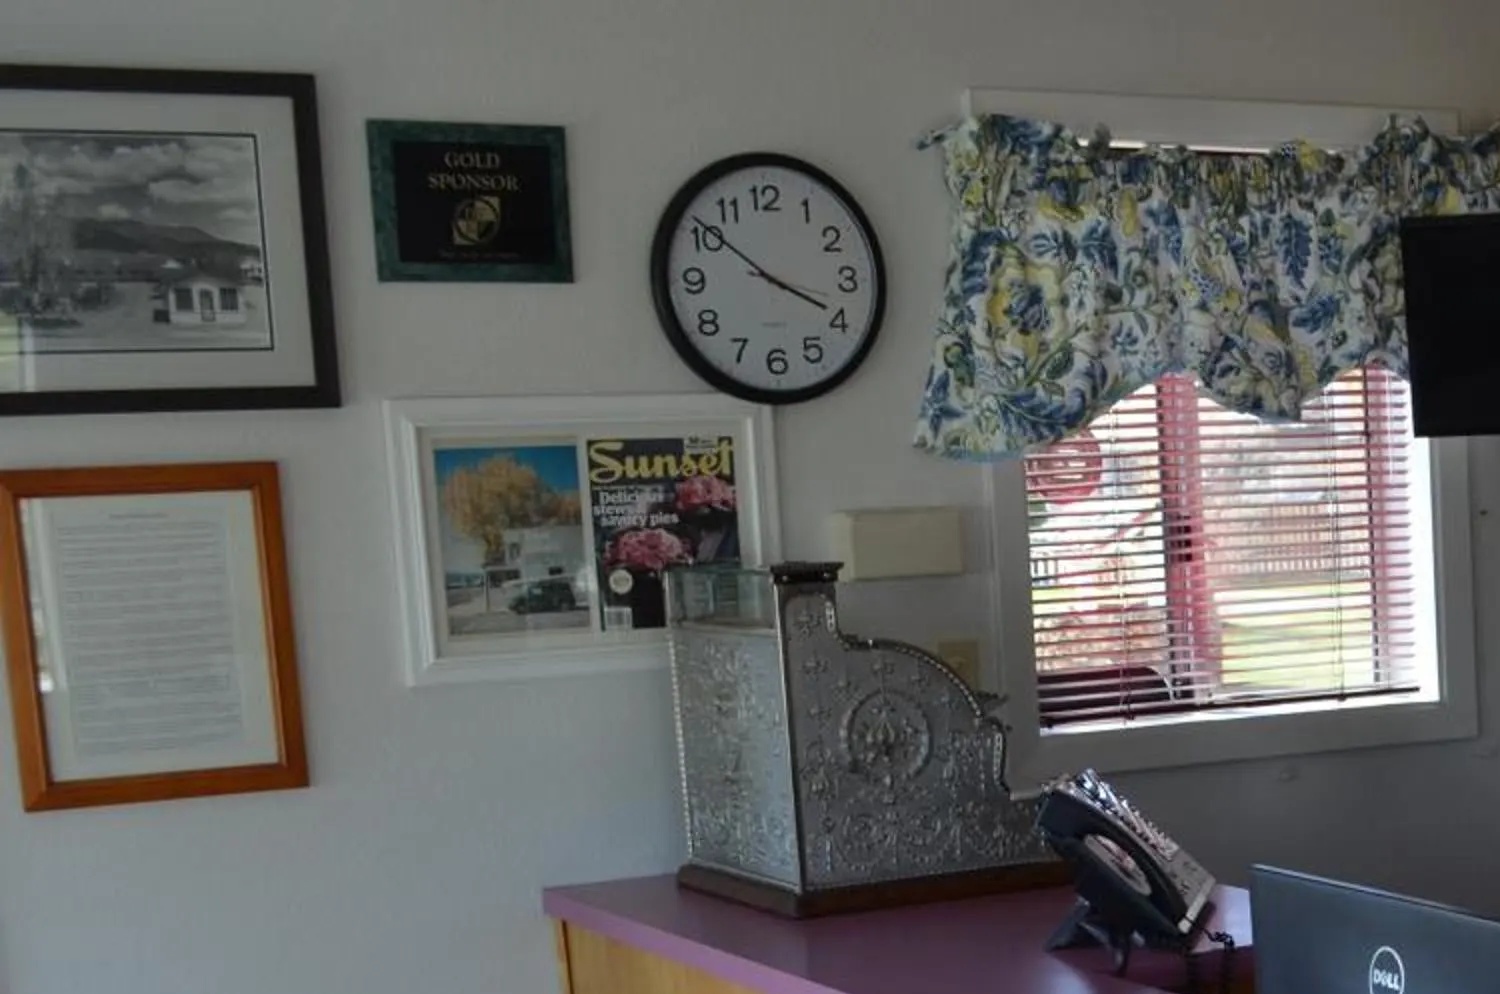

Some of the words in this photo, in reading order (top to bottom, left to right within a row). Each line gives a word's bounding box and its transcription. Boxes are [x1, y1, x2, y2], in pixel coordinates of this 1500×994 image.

[444, 151, 501, 169] GOLD
[427, 172, 522, 191] SPONSOR
[716, 197, 739, 225] 11
[750, 184, 781, 212] 12
[801, 197, 811, 225] 1
[691, 225, 724, 252] 10
[821, 226, 843, 253] 2
[682, 267, 706, 295] 9
[837, 265, 858, 293] 3
[697, 309, 720, 336] 8
[828, 306, 849, 334] 4
[730, 337, 749, 364] 7
[766, 348, 789, 375] 6
[802, 336, 824, 364] 5
[590, 440, 733, 484] Sunset
[649, 511, 680, 527] pies
[1373, 968, 1400, 990] DELL
